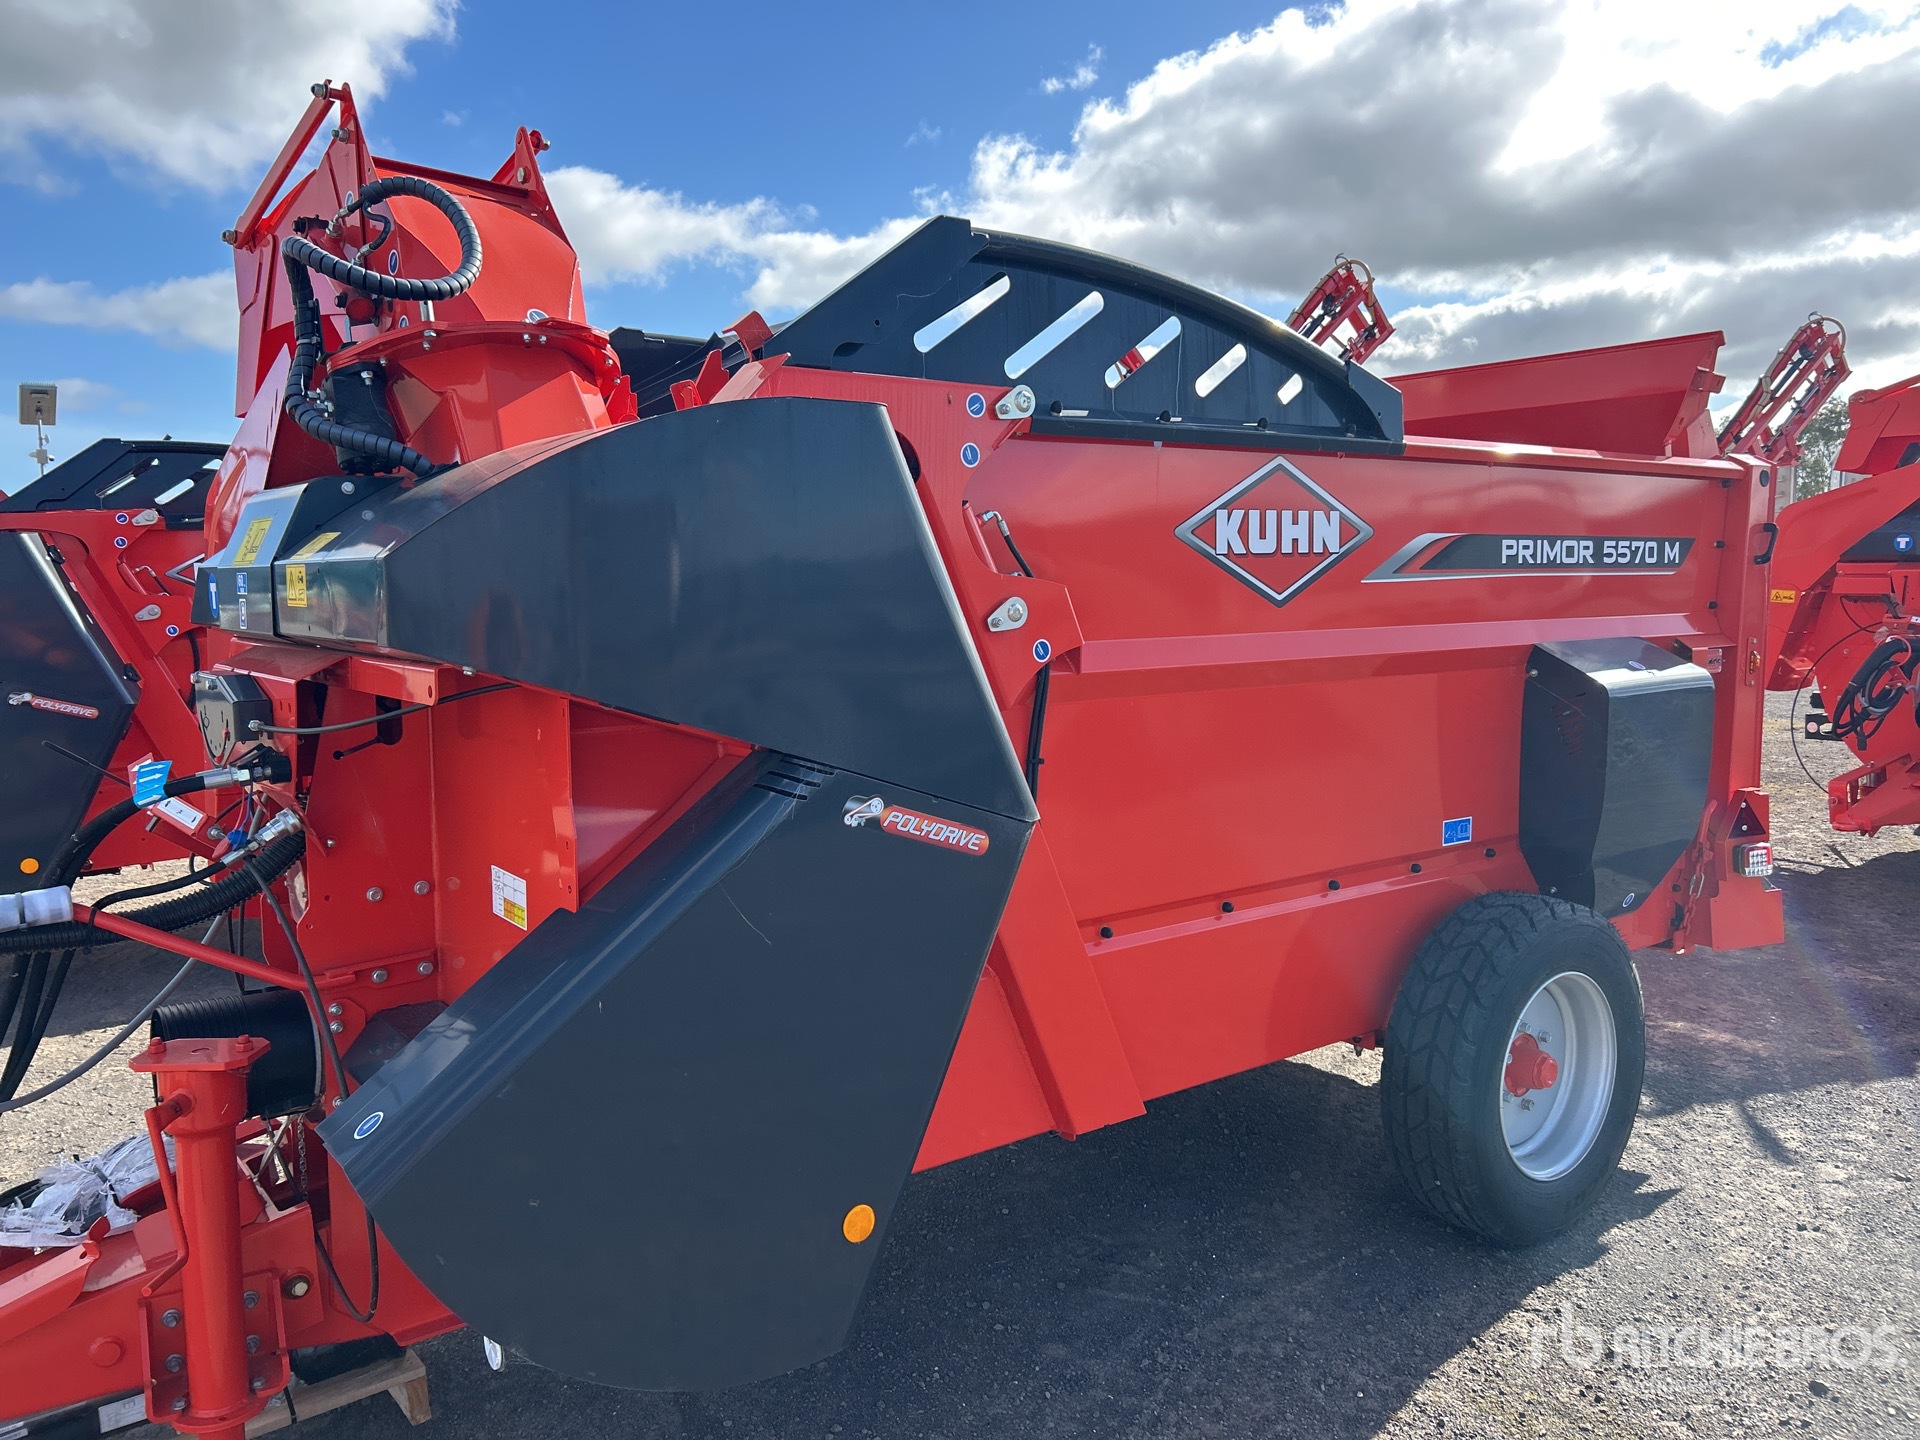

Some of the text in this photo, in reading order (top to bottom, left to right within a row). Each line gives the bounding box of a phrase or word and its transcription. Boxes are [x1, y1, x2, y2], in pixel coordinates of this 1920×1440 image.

[1215, 509, 1340, 555] KUHN
[1501, 539, 1680, 565] PRIMOR 5570 M
[32, 698, 96, 717] POLYDRIVE
[883, 811, 986, 851] POLYDRIVE
